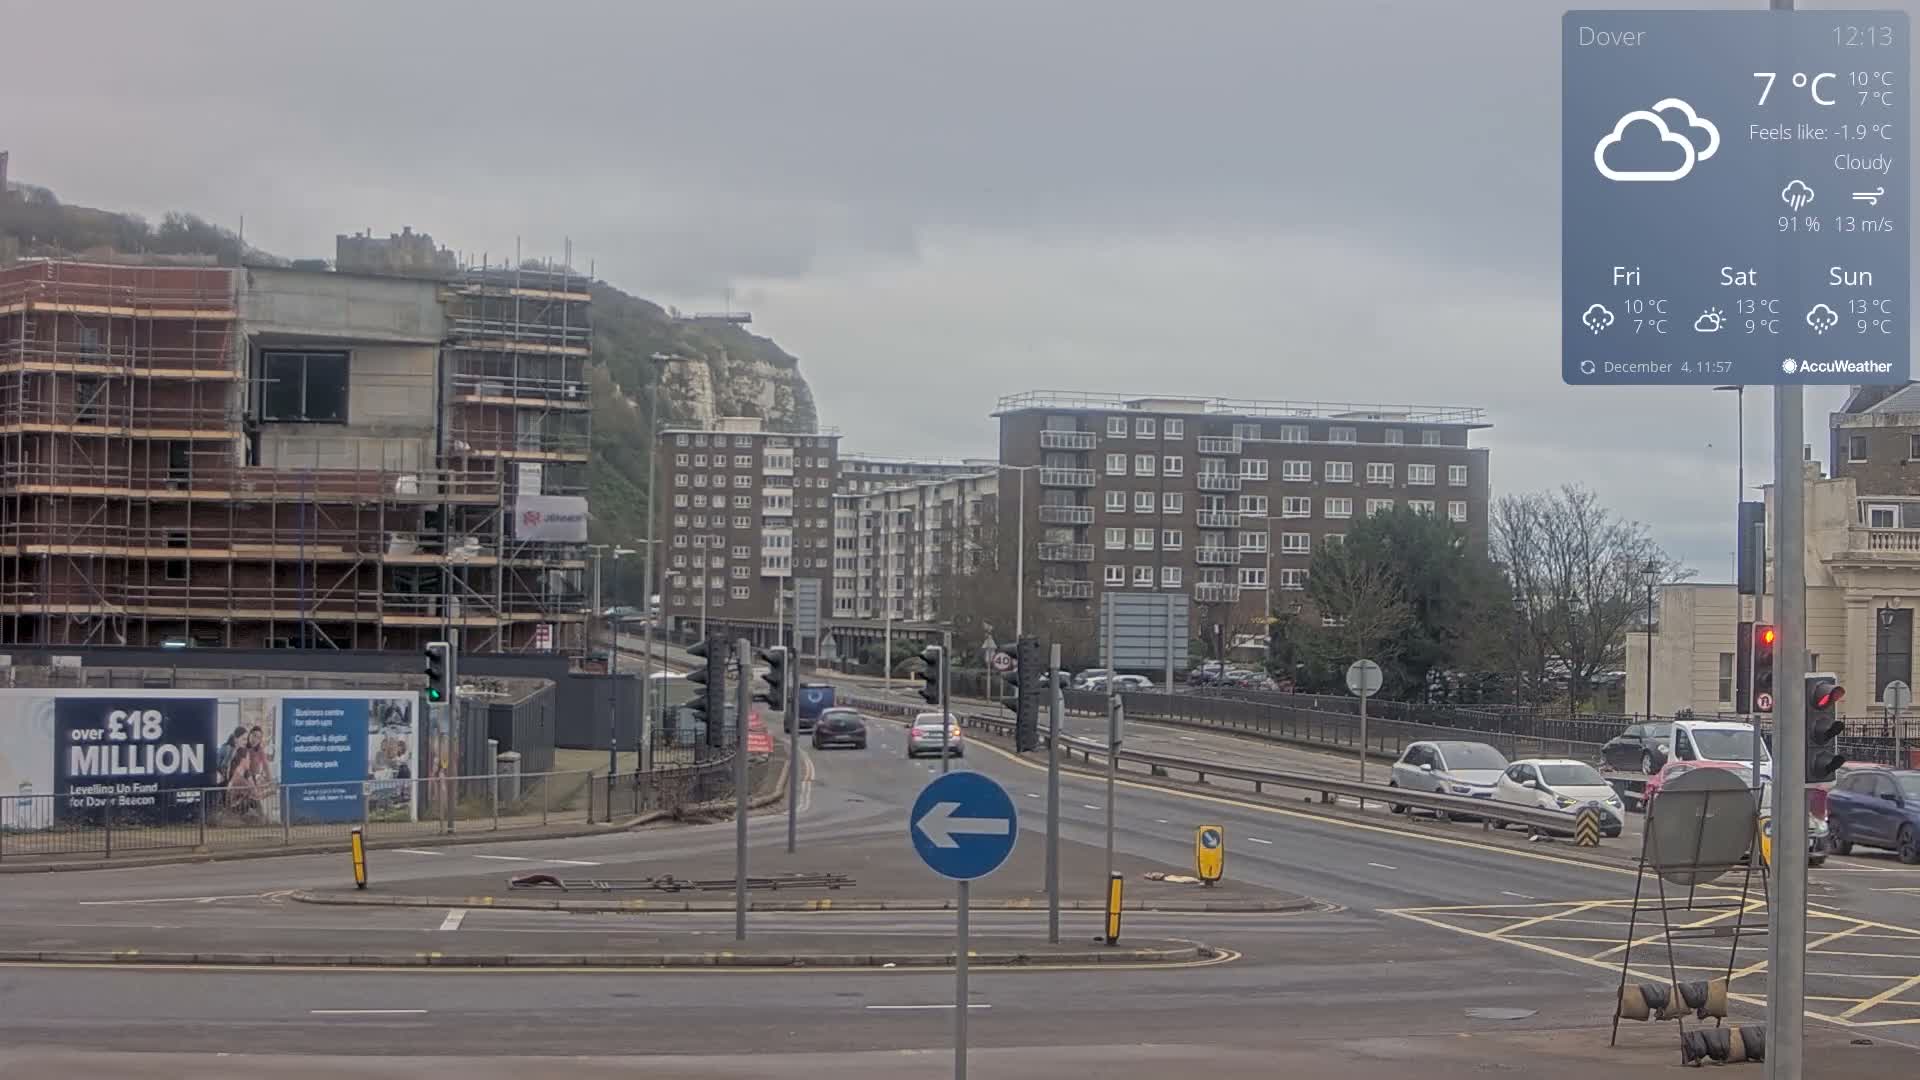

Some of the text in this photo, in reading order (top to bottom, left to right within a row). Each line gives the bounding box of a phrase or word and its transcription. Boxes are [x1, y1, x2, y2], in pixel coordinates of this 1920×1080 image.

[995, 656, 1010, 665] 40
[295, 708, 323, 716] Business
[71, 709, 163, 741] over £18
[294, 734, 321, 743] Creative
[294, 745, 326, 753] education
[70, 743, 204, 776] MILLION
[294, 760, 338, 770] Riverside park
[70, 783, 114, 798] Levelling
[133, 782, 158, 794] Fund
[119, 795, 156, 806] Beacon
